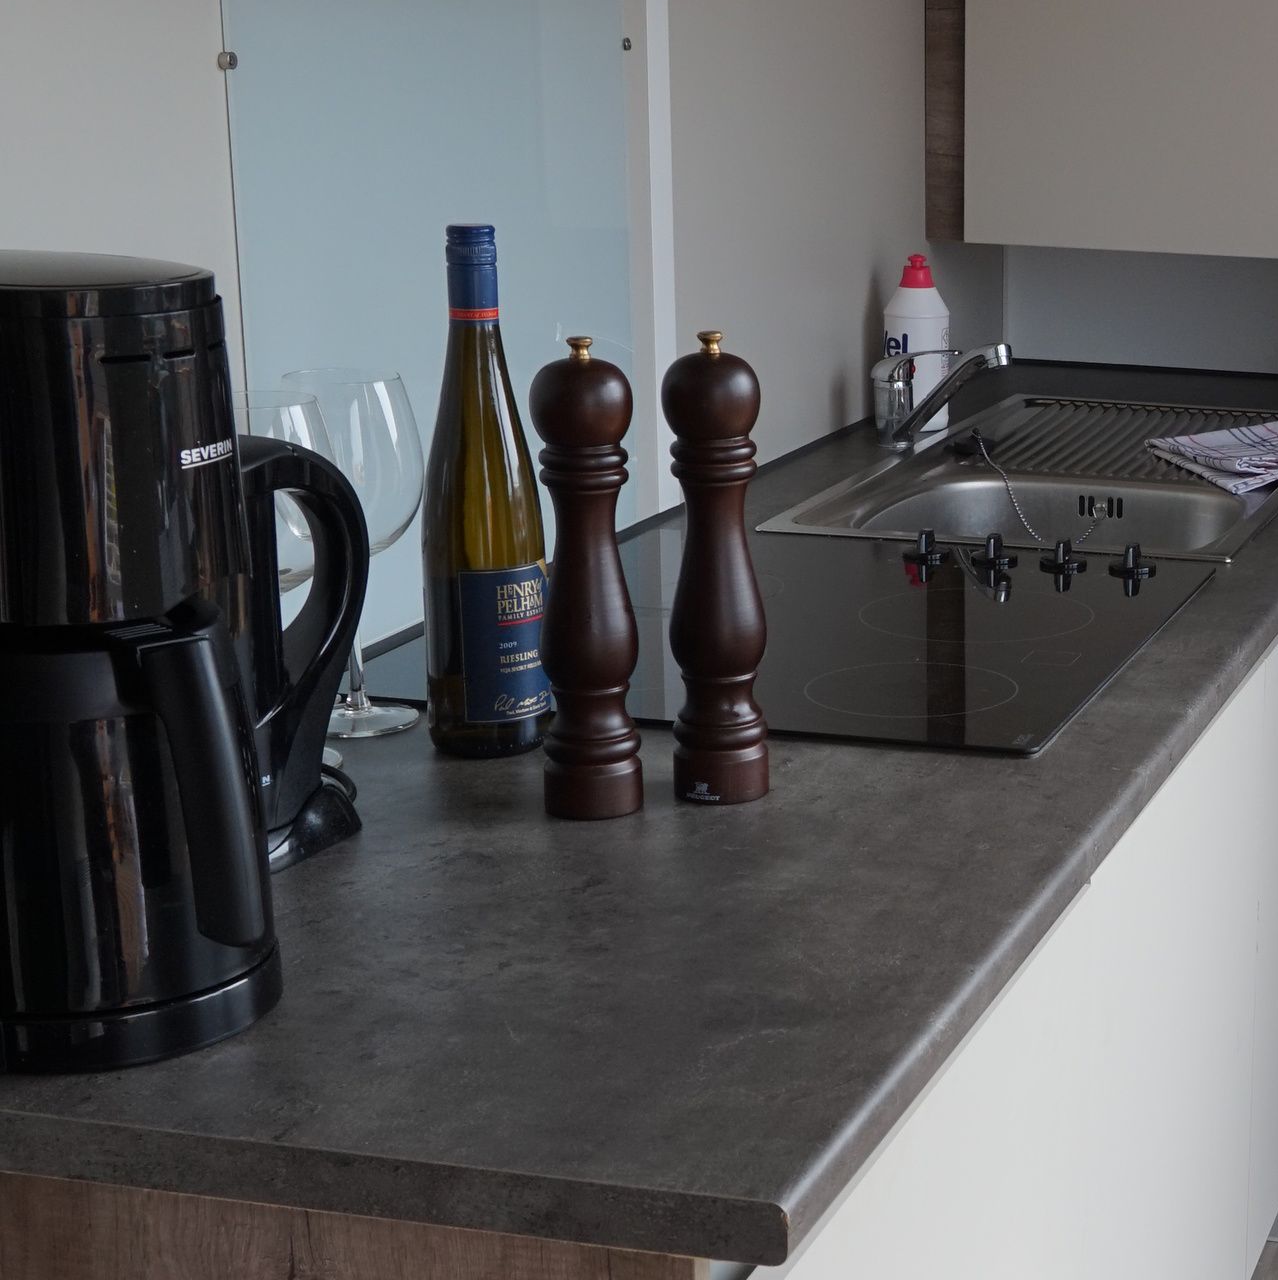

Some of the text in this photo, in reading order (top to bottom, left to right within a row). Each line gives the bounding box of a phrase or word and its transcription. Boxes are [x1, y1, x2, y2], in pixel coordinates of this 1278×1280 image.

[181, 438, 233, 465] SEVERIN
[496, 580, 539, 599] HENRY
[497, 594, 543, 614] PELHAM
[499, 641, 518, 650] 2009
[500, 649, 539, 664] RIESLING
